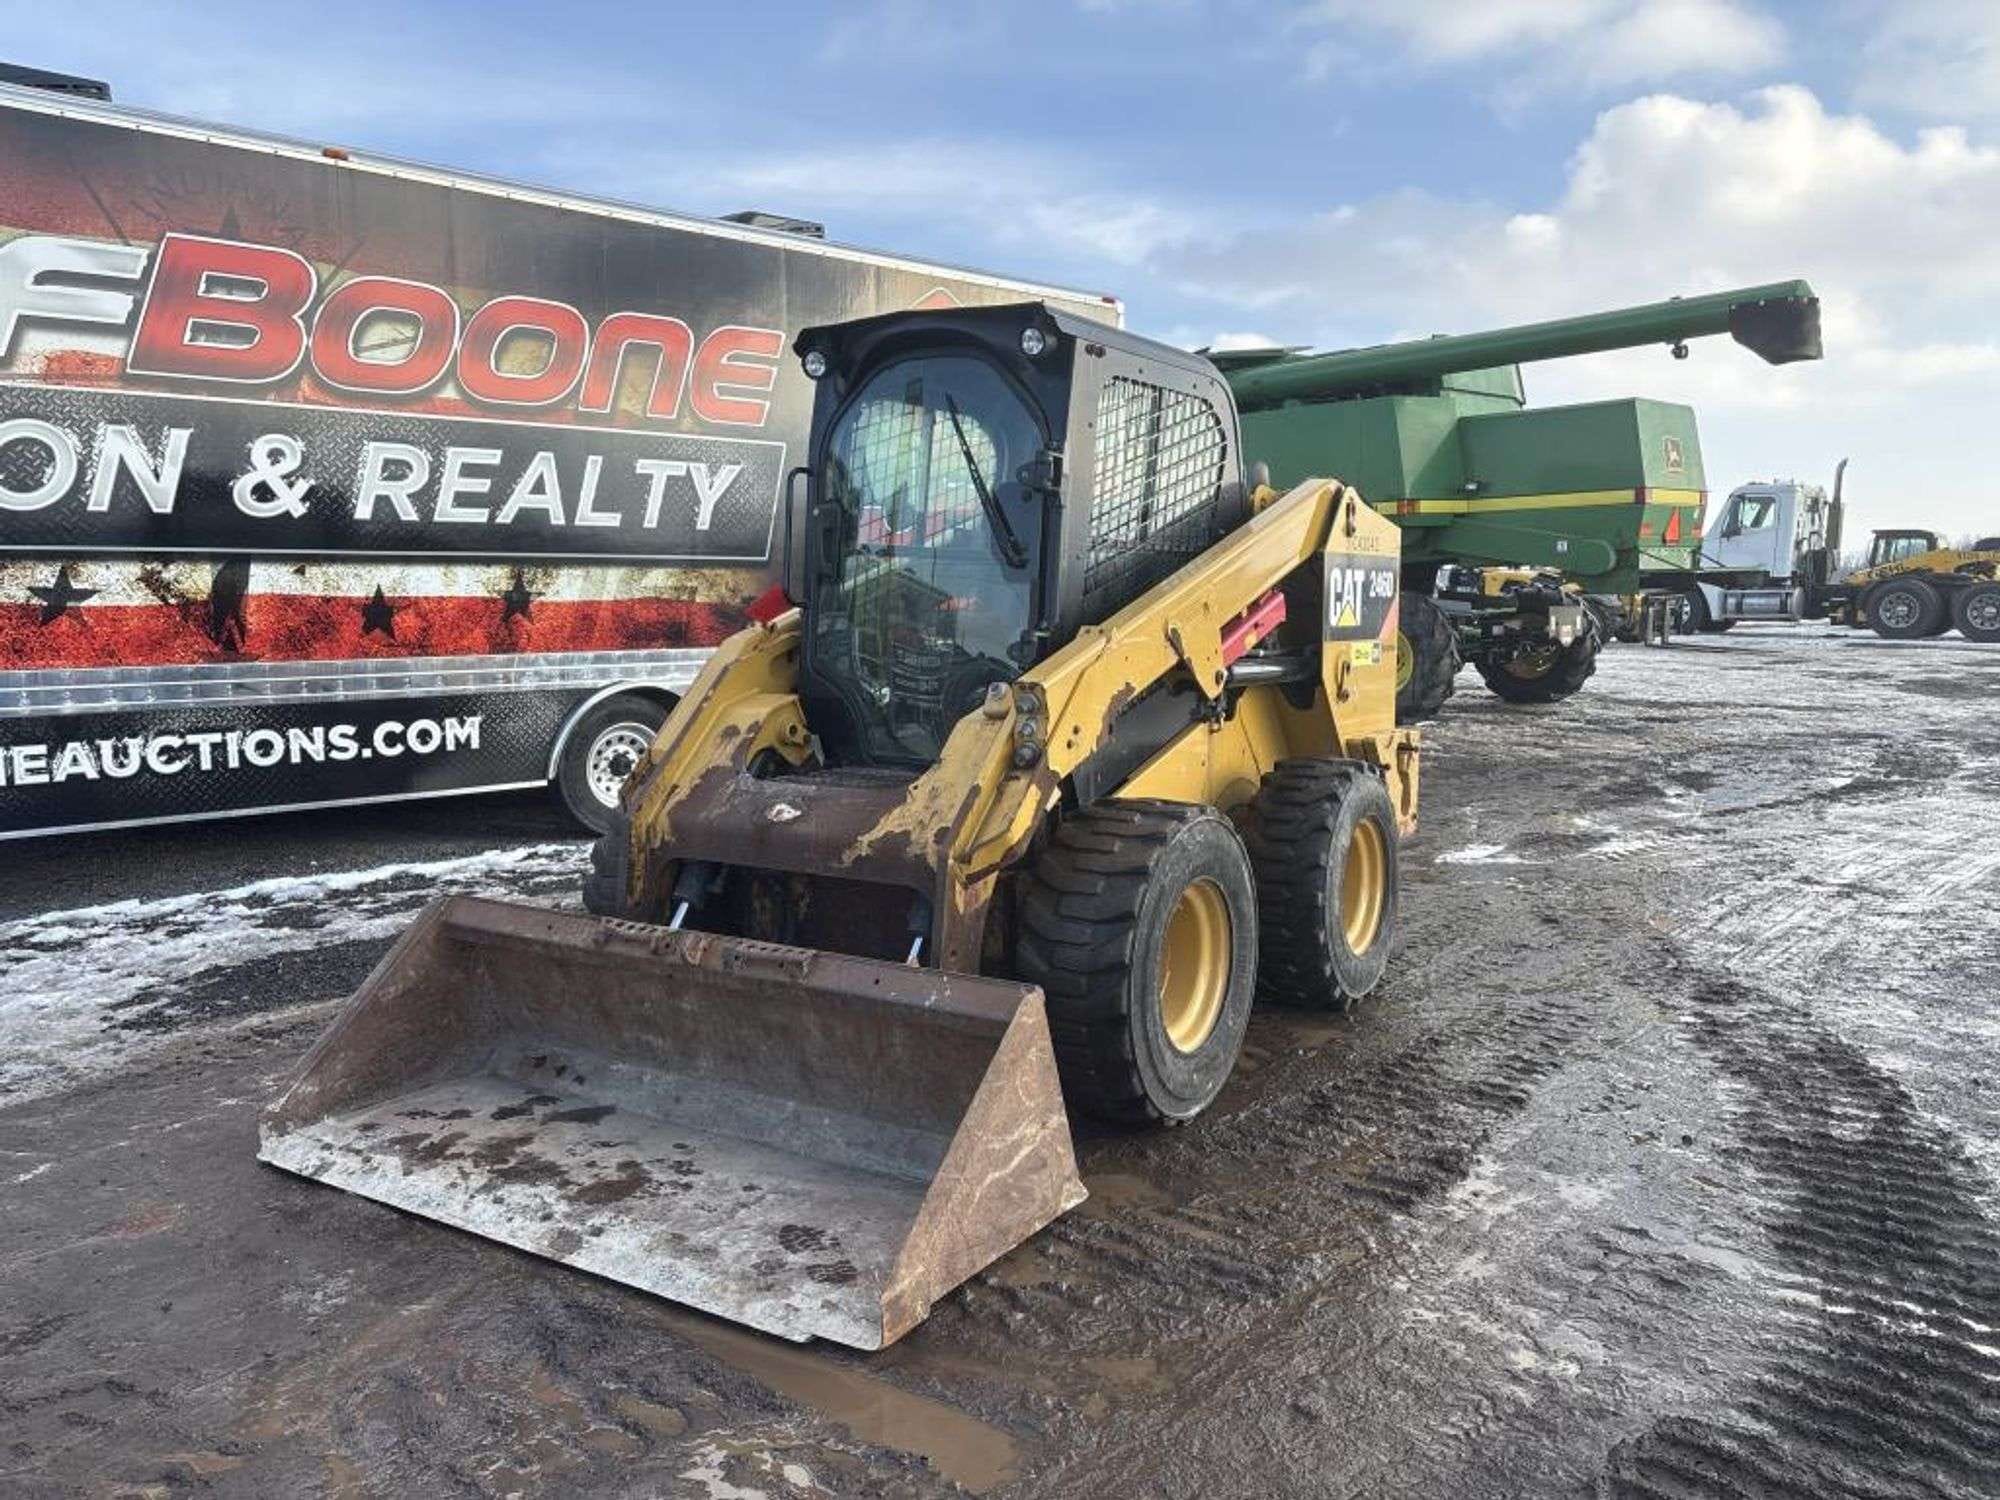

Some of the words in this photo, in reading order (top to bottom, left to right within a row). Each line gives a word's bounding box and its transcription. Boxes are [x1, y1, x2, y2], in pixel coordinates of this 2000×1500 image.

[0, 417, 194, 513] ON
[232, 432, 312, 520] &
[353, 440, 743, 531] REALTY
[1329, 567, 1366, 627] CAT
[0, 715, 482, 786] EAUCTIONS.COM
